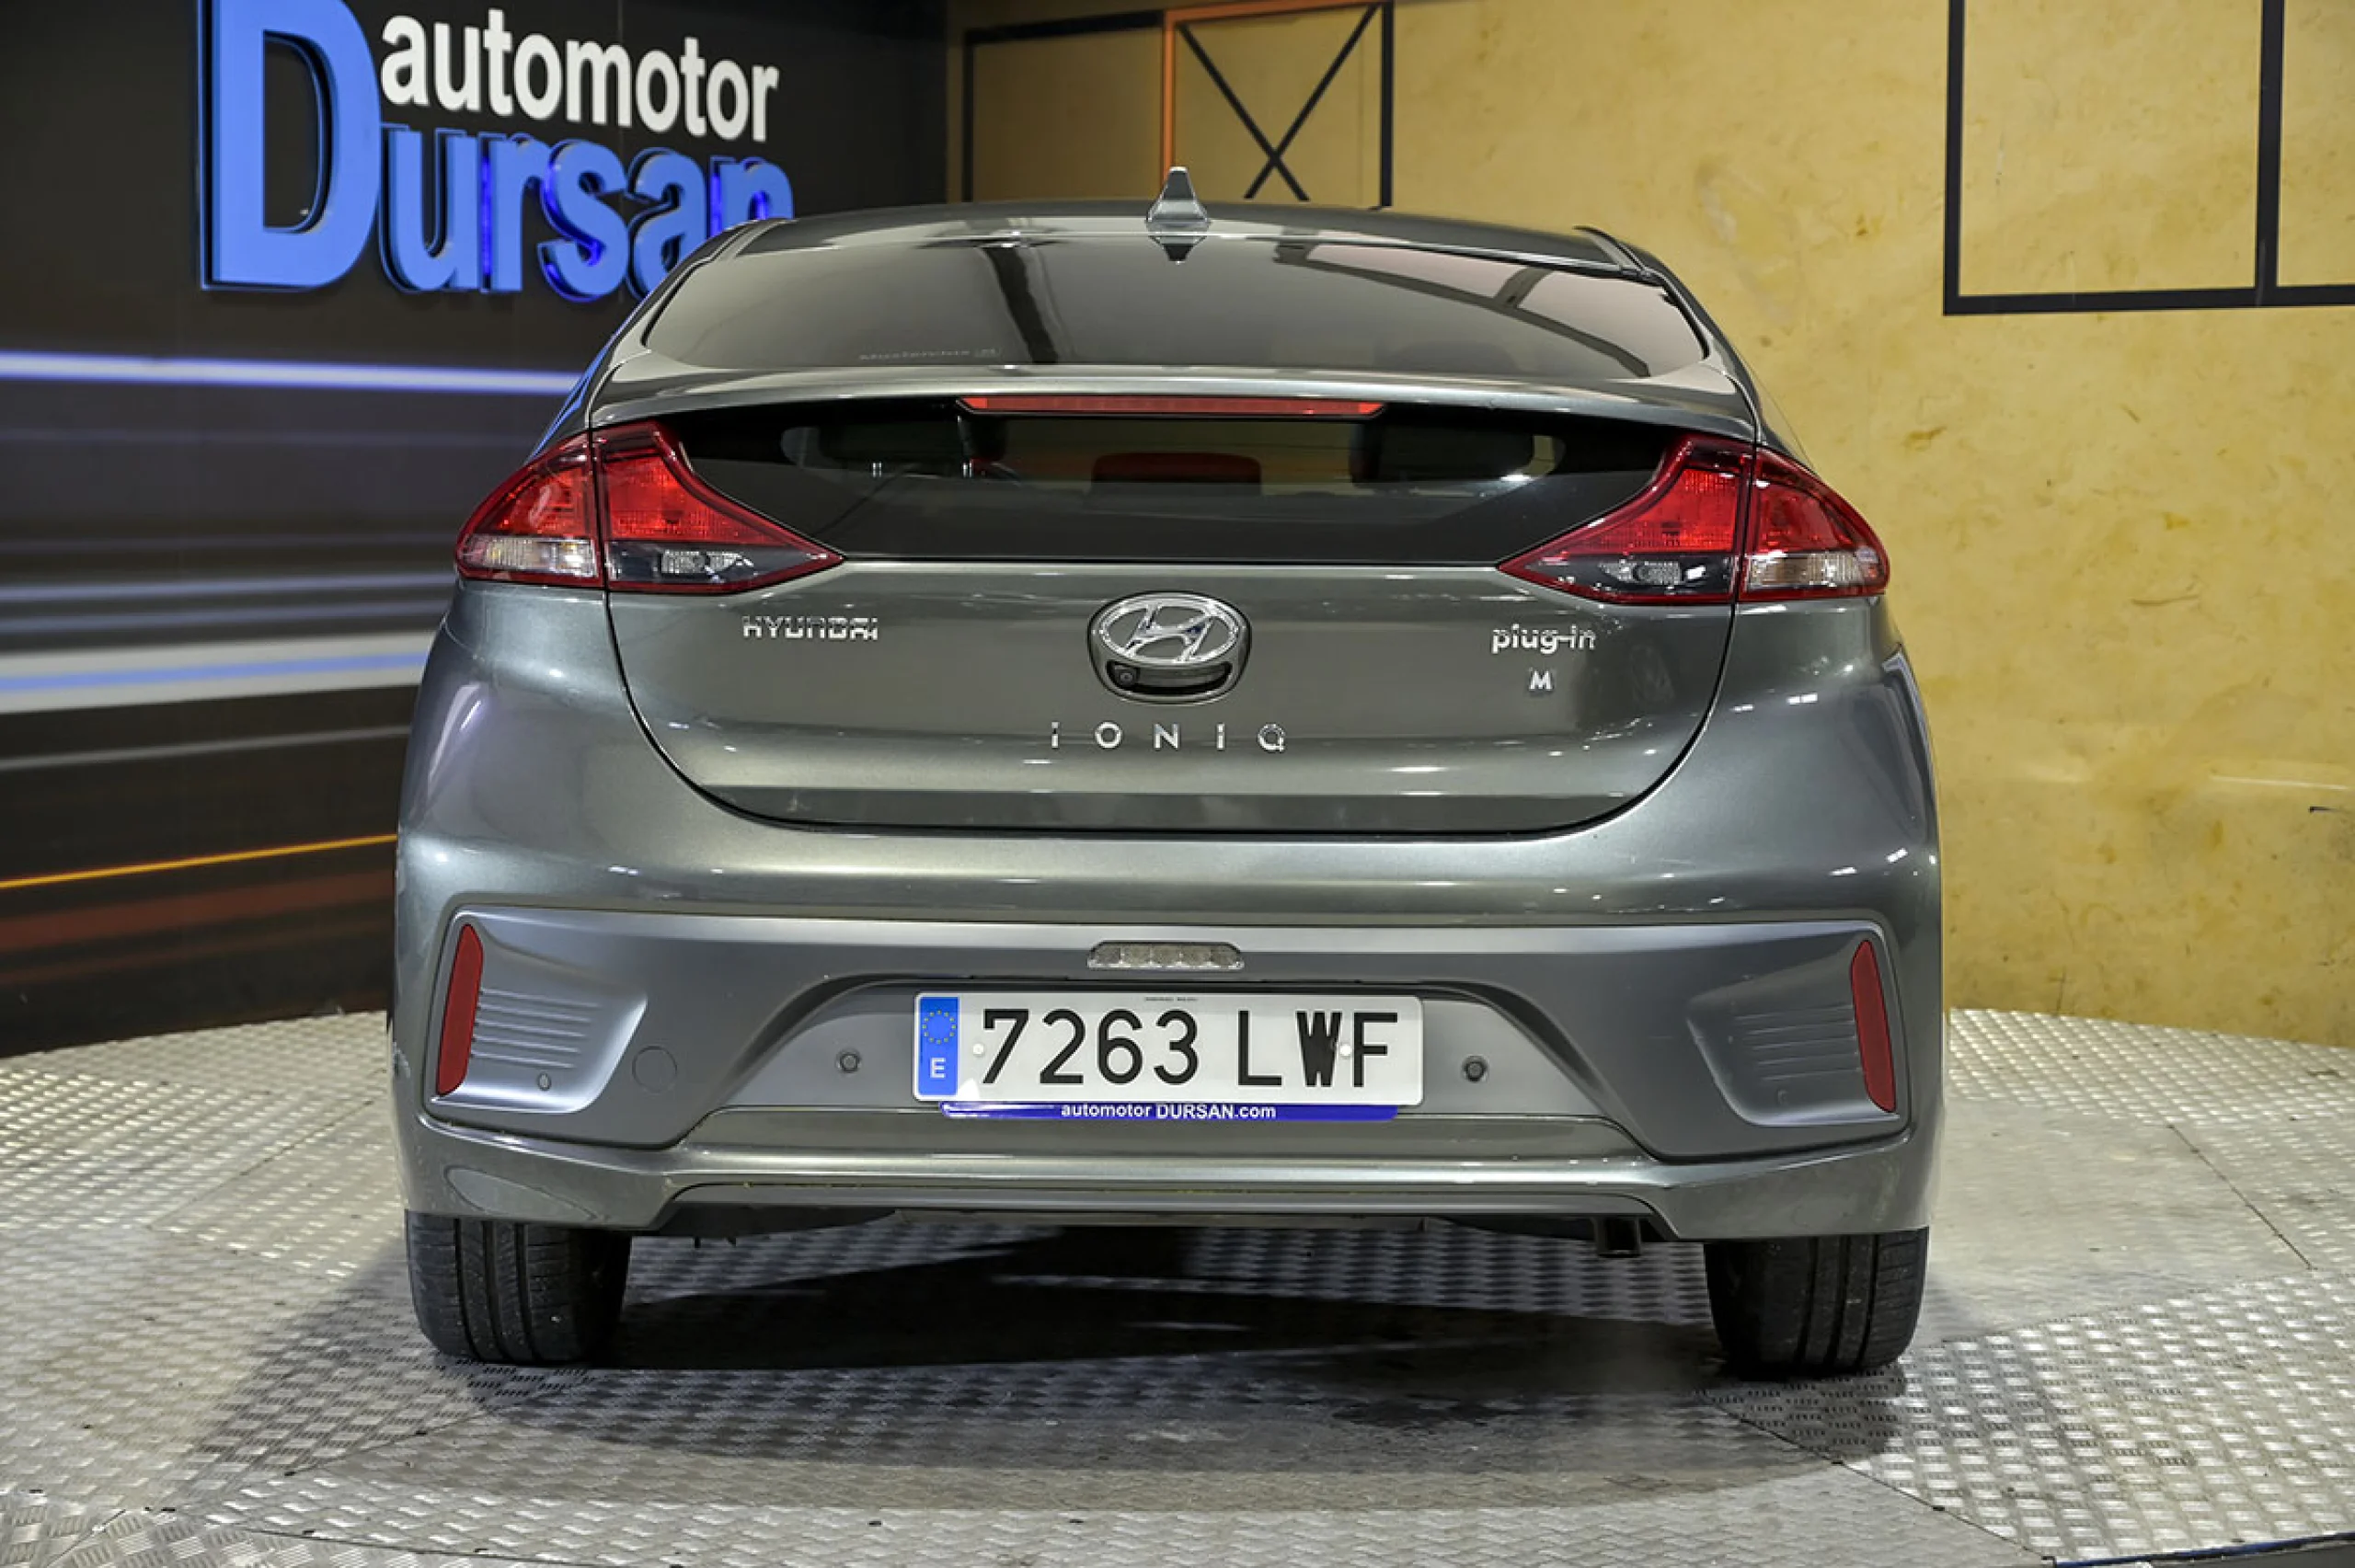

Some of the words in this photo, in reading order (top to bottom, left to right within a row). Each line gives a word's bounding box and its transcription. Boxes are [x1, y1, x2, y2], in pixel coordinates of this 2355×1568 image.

[381, 9, 778, 142] automotor
[742, 615, 879, 641] HYUNDAI
[1491, 624, 1596, 655] plug-in
[1528, 670, 1554, 691] M
[1051, 721, 1286, 752] IONIQ
[982, 1008, 1198, 1086] 7263
[1237, 1010, 1398, 1088] LWF
[930, 1058, 947, 1079] E
[1060, 1103, 1152, 1117] automotor
[1155, 1103, 1277, 1120] DURSAN.com
